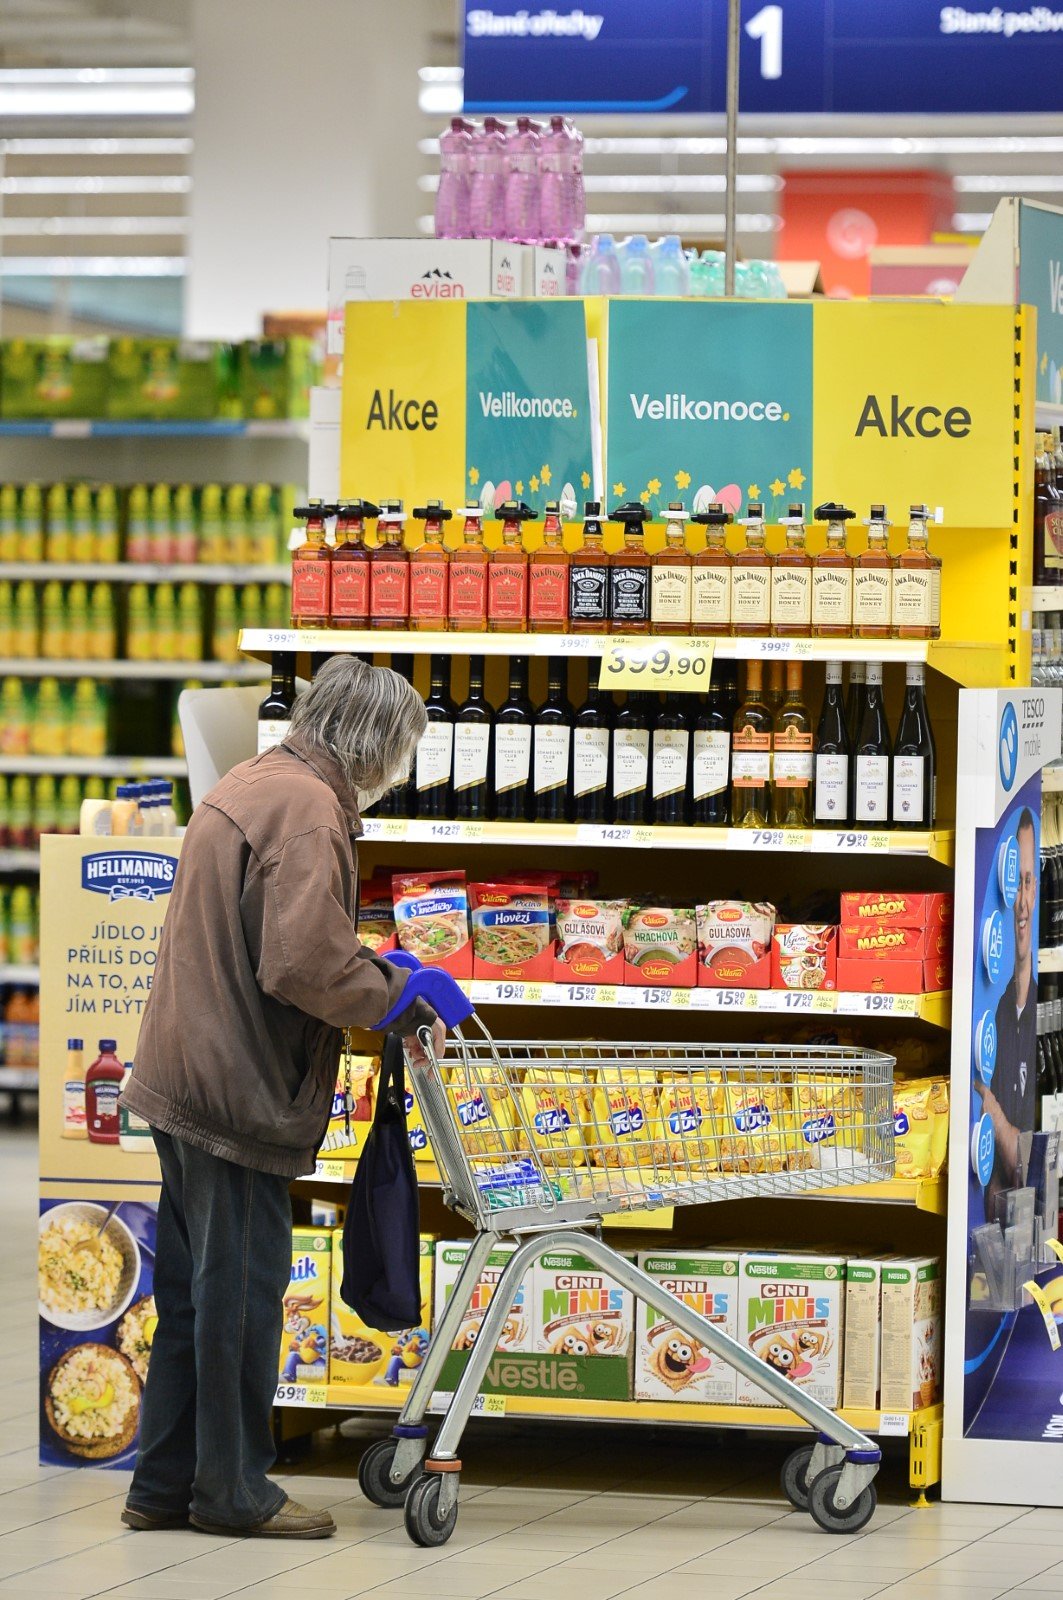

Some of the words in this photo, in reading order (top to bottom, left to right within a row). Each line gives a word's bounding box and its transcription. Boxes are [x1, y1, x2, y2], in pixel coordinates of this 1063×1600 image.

[745, 5, 784, 79] 1
[411, 281, 465, 298] evian
[497, 274, 515, 292] evian
[541, 279, 559, 297] evian
[366, 389, 439, 432] Akce
[479, 391, 578, 419] Velikonoce.
[629, 392, 791, 422] Velikonoce.
[854, 395, 972, 438] Akce
[654, 574, 667, 584] JACK
[694, 574, 706, 585] JACK
[734, 574, 746, 585] JACK
[774, 574, 786, 586] JACK
[814, 574, 827, 586] JACK
[856, 574, 868, 586] JACK
[894, 576, 908, 587] JACK
[686, 640, 710, 648] -38%
[607, 648, 706, 678] 399,90
[1022, 698, 1045, 718] TESCO
[432, 826, 452, 836] 142
[600, 830, 621, 840] 142
[752, 831, 773, 845] 79
[836, 833, 857, 846] 79
[87, 858, 174, 881] HELLMANN'S
[858, 900, 907, 918] MASOX
[495, 912, 530, 926] Hovězí
[92, 920, 145, 940] JÍDLO
[564, 922, 606, 936] GULÁŠOVÁ
[634, 930, 678, 942] HRACHOVÁ
[709, 925, 751, 938] GULÁŠOVÁ
[858, 932, 906, 950] MASOX
[68, 944, 123, 965] PŘÍLIŠ
[575, 962, 600, 973] Vitana
[646, 966, 670, 977] Vitana
[718, 968, 744, 978] Vitana
[68, 974, 93, 988] NA
[99, 974, 128, 992] TO,
[496, 984, 512, 998] 19
[568, 986, 584, 1000] 15
[642, 989, 660, 1003] 15
[716, 991, 734, 1005] 15
[66, 994, 96, 1014] JÍM
[102, 994, 150, 1014] PLÝT
[784, 993, 802, 1007] 17
[864, 996, 882, 1010] 19
[883, 996, 894, 1004] 90
[648, 1261, 677, 1271] Nestlé
[749, 1265, 778, 1275] Nestlé
[557, 1276, 600, 1289] CINI
[662, 1280, 704, 1293] CINI
[762, 1284, 806, 1298] CINI
[484, 1359, 578, 1392] Nestlé
[276, 1386, 296, 1400] 69
[296, 1387, 306, 1395] 90
